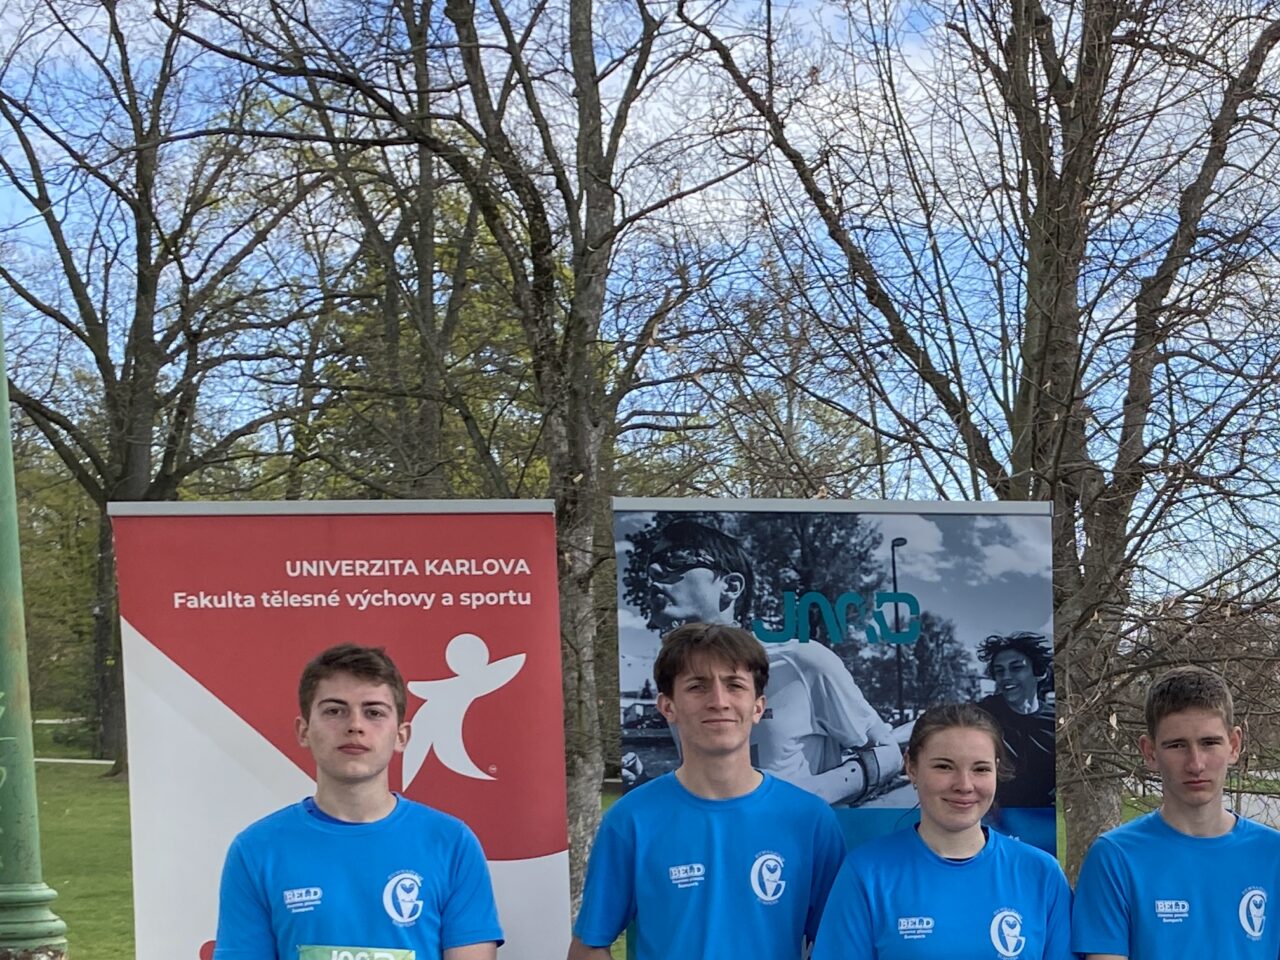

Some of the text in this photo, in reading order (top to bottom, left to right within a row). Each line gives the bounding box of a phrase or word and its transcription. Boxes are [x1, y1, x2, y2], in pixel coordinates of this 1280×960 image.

[285, 559, 532, 577] UNIVERZITA KARLOVA
[173, 589, 532, 611] Fakulta tělesné výchovy a sportu
